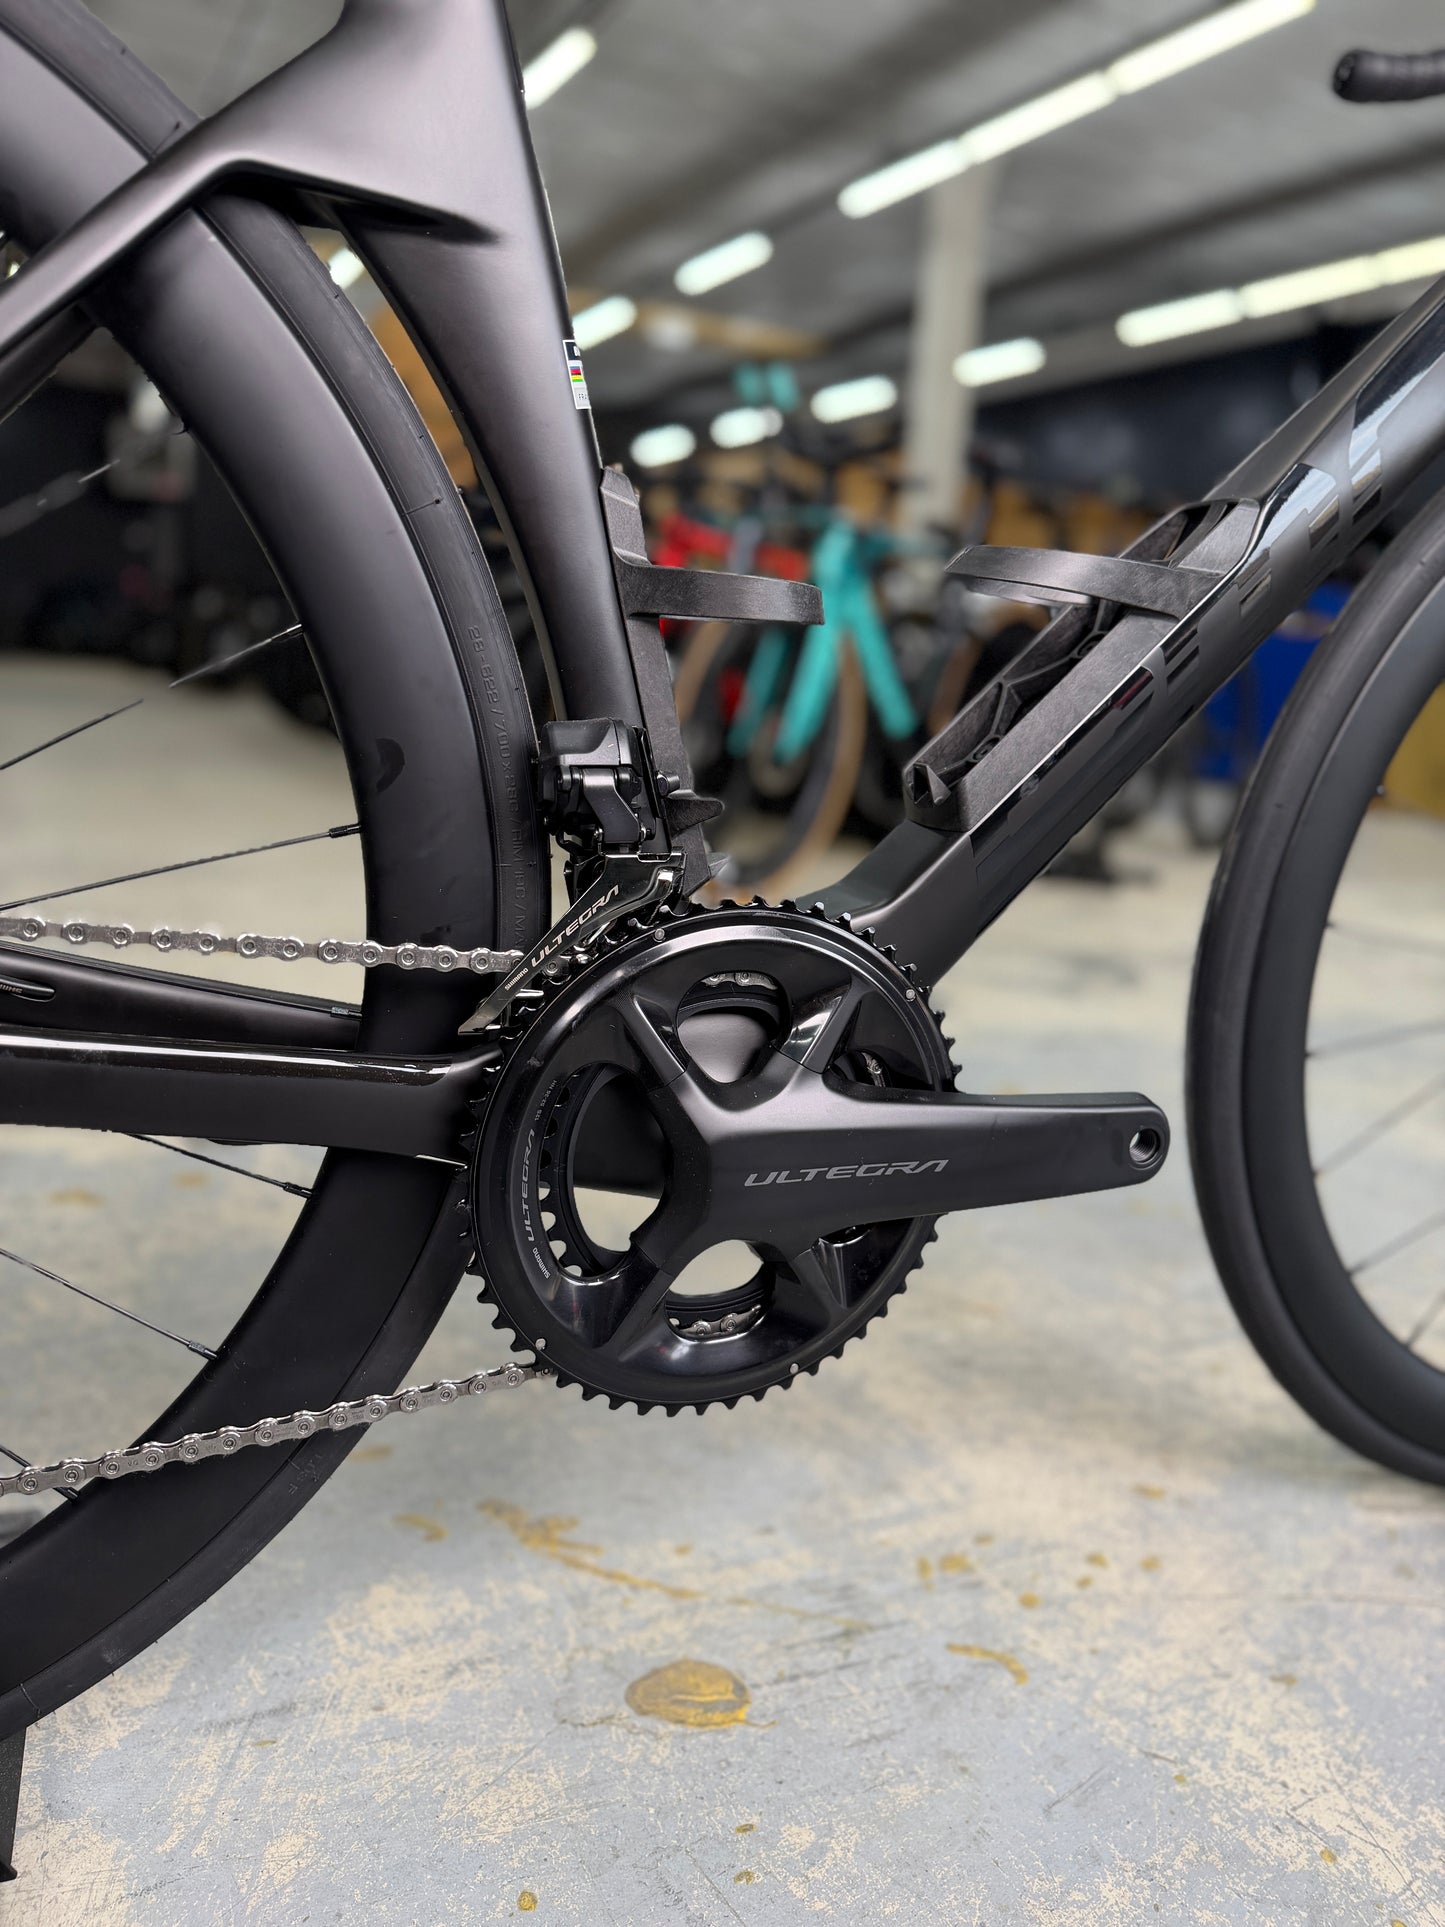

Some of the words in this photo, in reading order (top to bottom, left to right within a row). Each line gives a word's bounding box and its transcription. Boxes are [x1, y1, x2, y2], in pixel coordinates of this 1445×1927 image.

[504, 967, 529, 991] SHIMANO
[531, 884, 619, 968] ULTEGRA
[521, 1128, 536, 1242] ULTEGRA
[744, 1159, 950, 1187] ULTEGRA
[532, 1247, 551, 1279] SHIMANO
